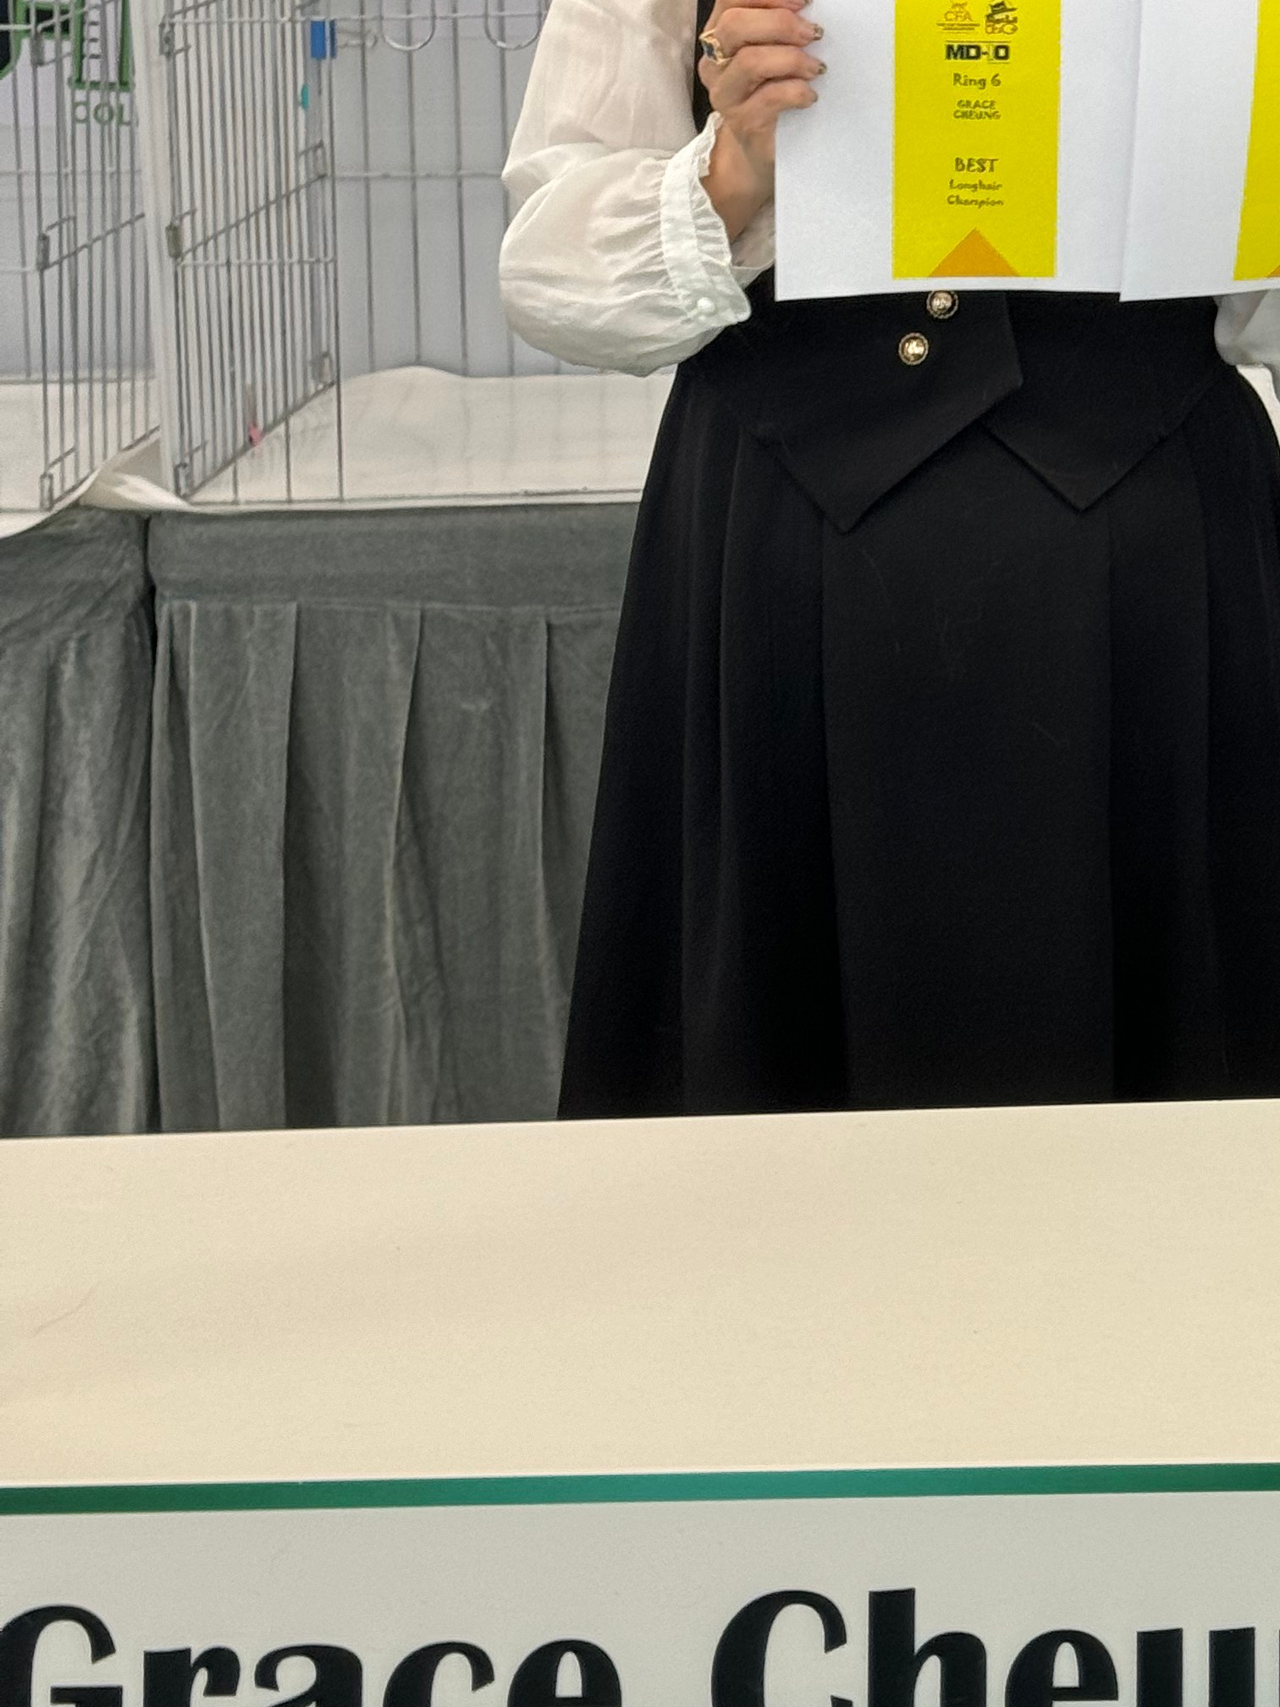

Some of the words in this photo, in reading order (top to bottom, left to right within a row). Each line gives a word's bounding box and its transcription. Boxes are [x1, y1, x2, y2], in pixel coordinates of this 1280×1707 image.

[953, 73, 986, 90] Ring
[991, 73, 1001, 87] 6
[955, 157, 999, 173] BEST
[0, 1603, 623, 1707] Grace
